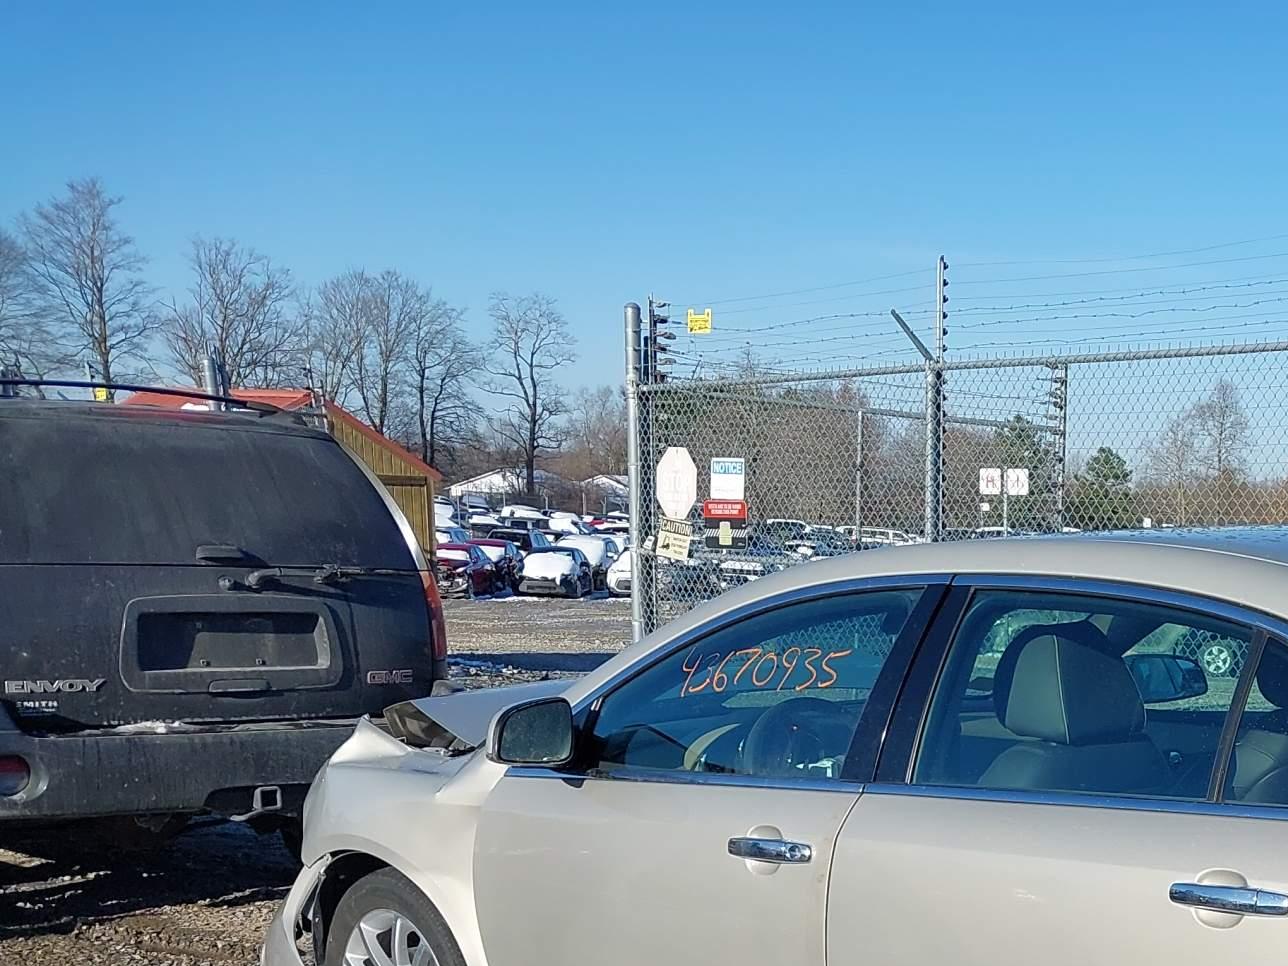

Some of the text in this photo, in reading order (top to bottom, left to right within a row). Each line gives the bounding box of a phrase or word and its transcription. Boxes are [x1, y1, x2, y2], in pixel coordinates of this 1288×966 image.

[713, 462, 742, 473] NOTICE
[367, 669, 413, 684] GMC
[680, 646, 853, 698] 43670935
[4, 678, 107, 694] ENVOY
[16, 700, 59, 708] SMITH
